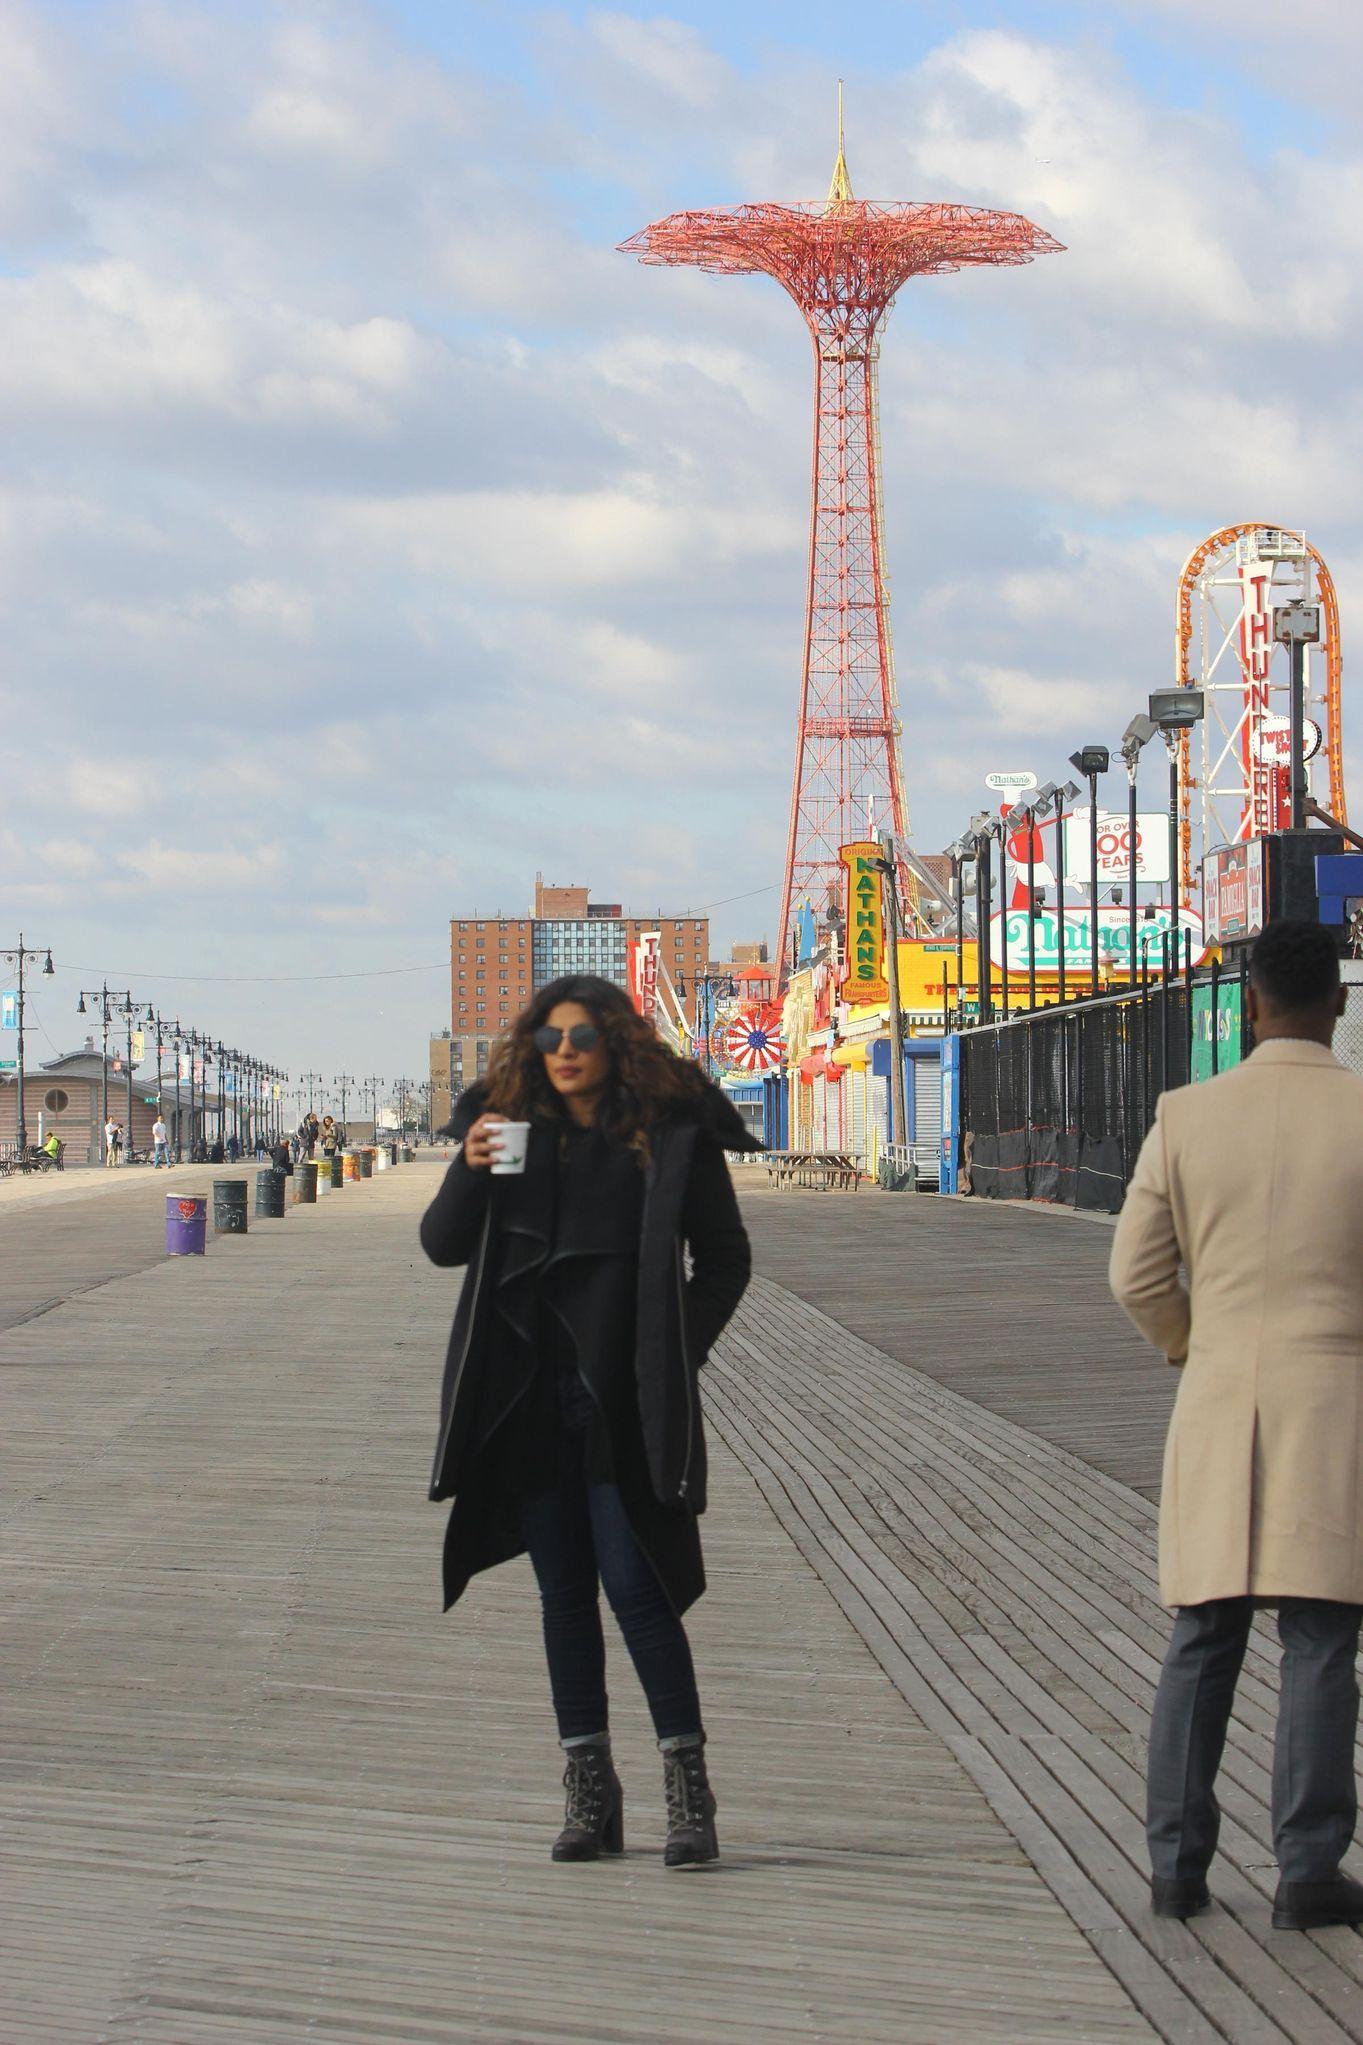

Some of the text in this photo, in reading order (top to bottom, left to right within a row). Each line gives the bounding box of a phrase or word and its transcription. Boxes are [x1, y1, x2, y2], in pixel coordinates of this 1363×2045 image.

[989, 774, 1030, 784] Nathan's
[1097, 820, 1140, 833] OR OVR
[1096, 831, 1143, 855] 00
[845, 848, 882, 856] ORIGINA
[856, 857, 875, 981] NATHANS
[966, 1003, 976, 1012] W
